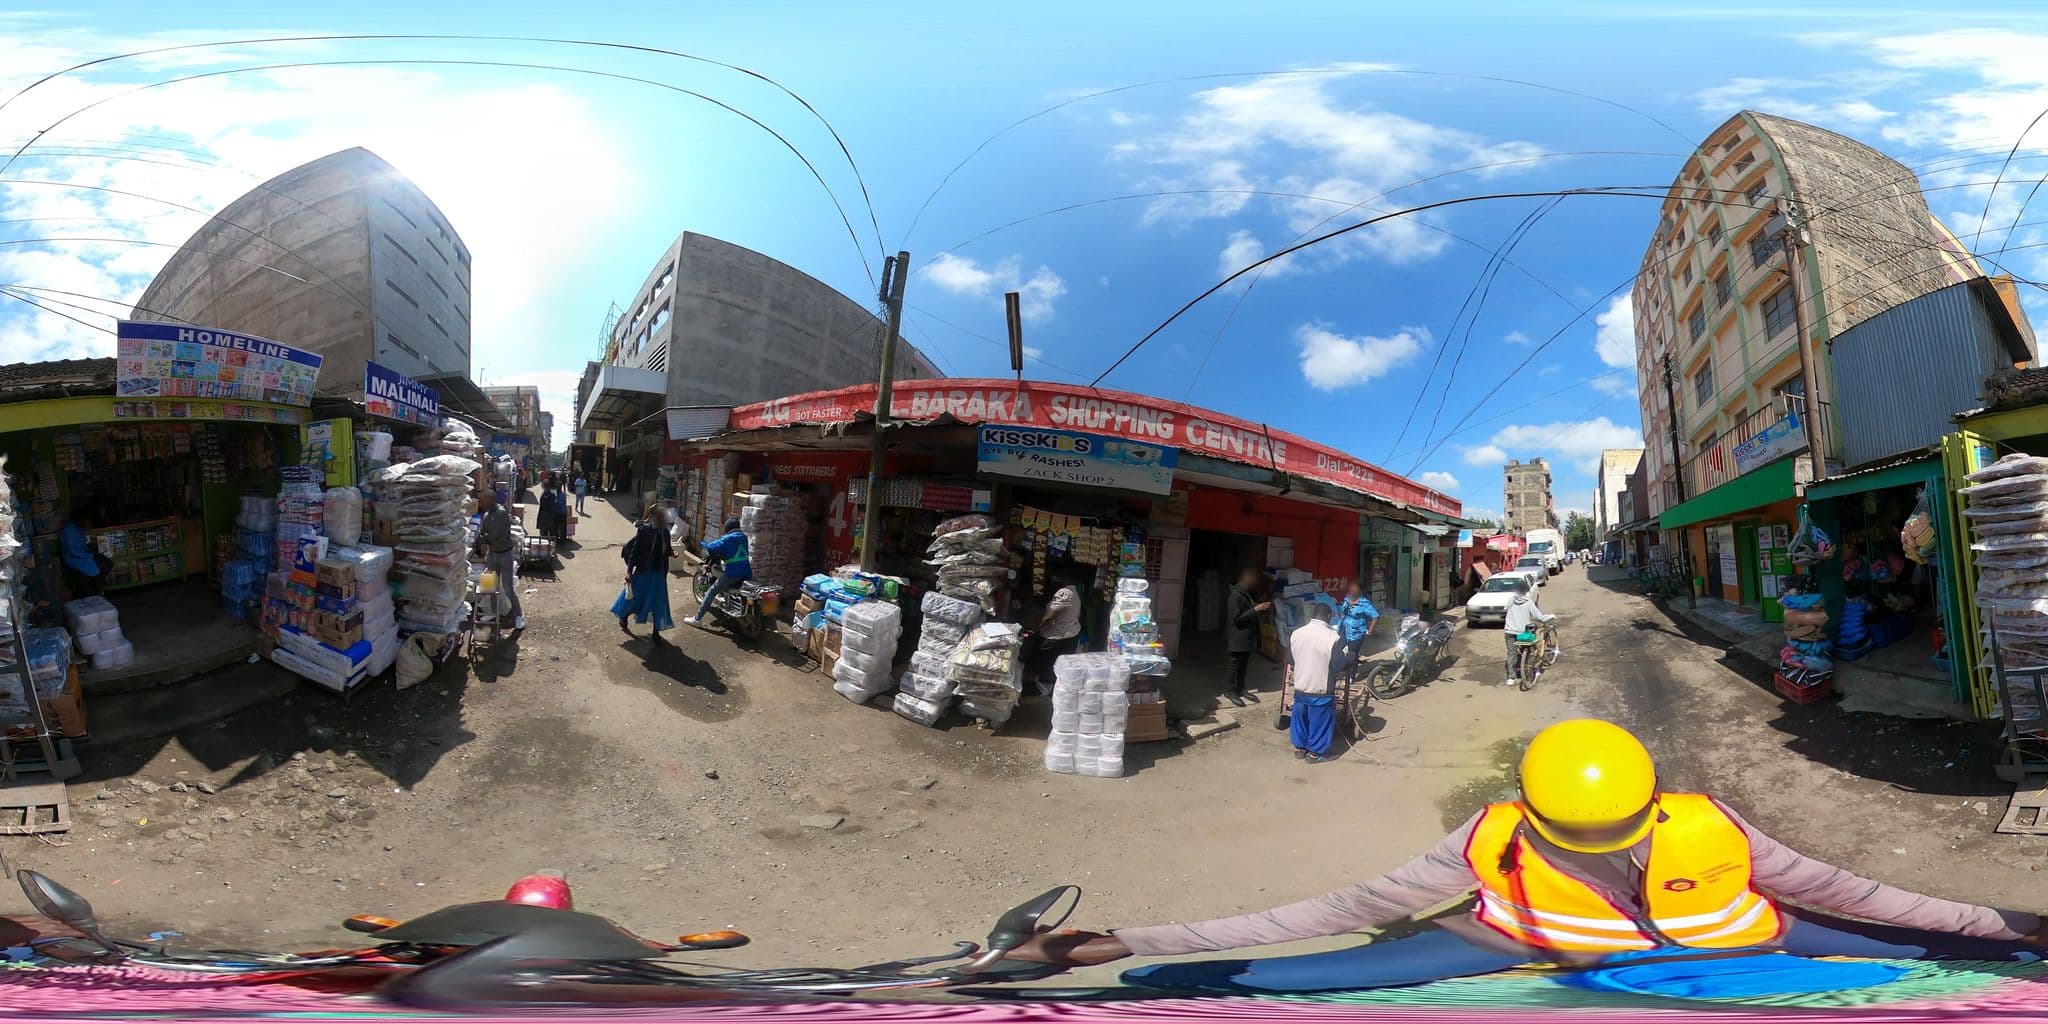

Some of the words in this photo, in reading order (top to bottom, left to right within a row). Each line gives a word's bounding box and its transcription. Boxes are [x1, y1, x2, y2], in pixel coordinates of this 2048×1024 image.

[178, 328, 290, 359] HOMELINE
[397, 374, 429, 394] JIMMY
[371, 376, 438, 415] MALIMALI
[761, 397, 790, 422] 4G
[794, 410, 811, 420] GOT
[812, 407, 842, 419] FASTER
[1049, 395, 1175, 439] SHOPPING
[1186, 418, 1287, 464] CENTRE
[984, 447, 1003, 455] BYE
[1007, 448, 1027, 459] BYE
[1316, 453, 1341, 473] Dial
[1023, 468, 1064, 480] ZACK
[1066, 472, 1105, 485] SHOP
[1107, 477, 1115, 486] 2
